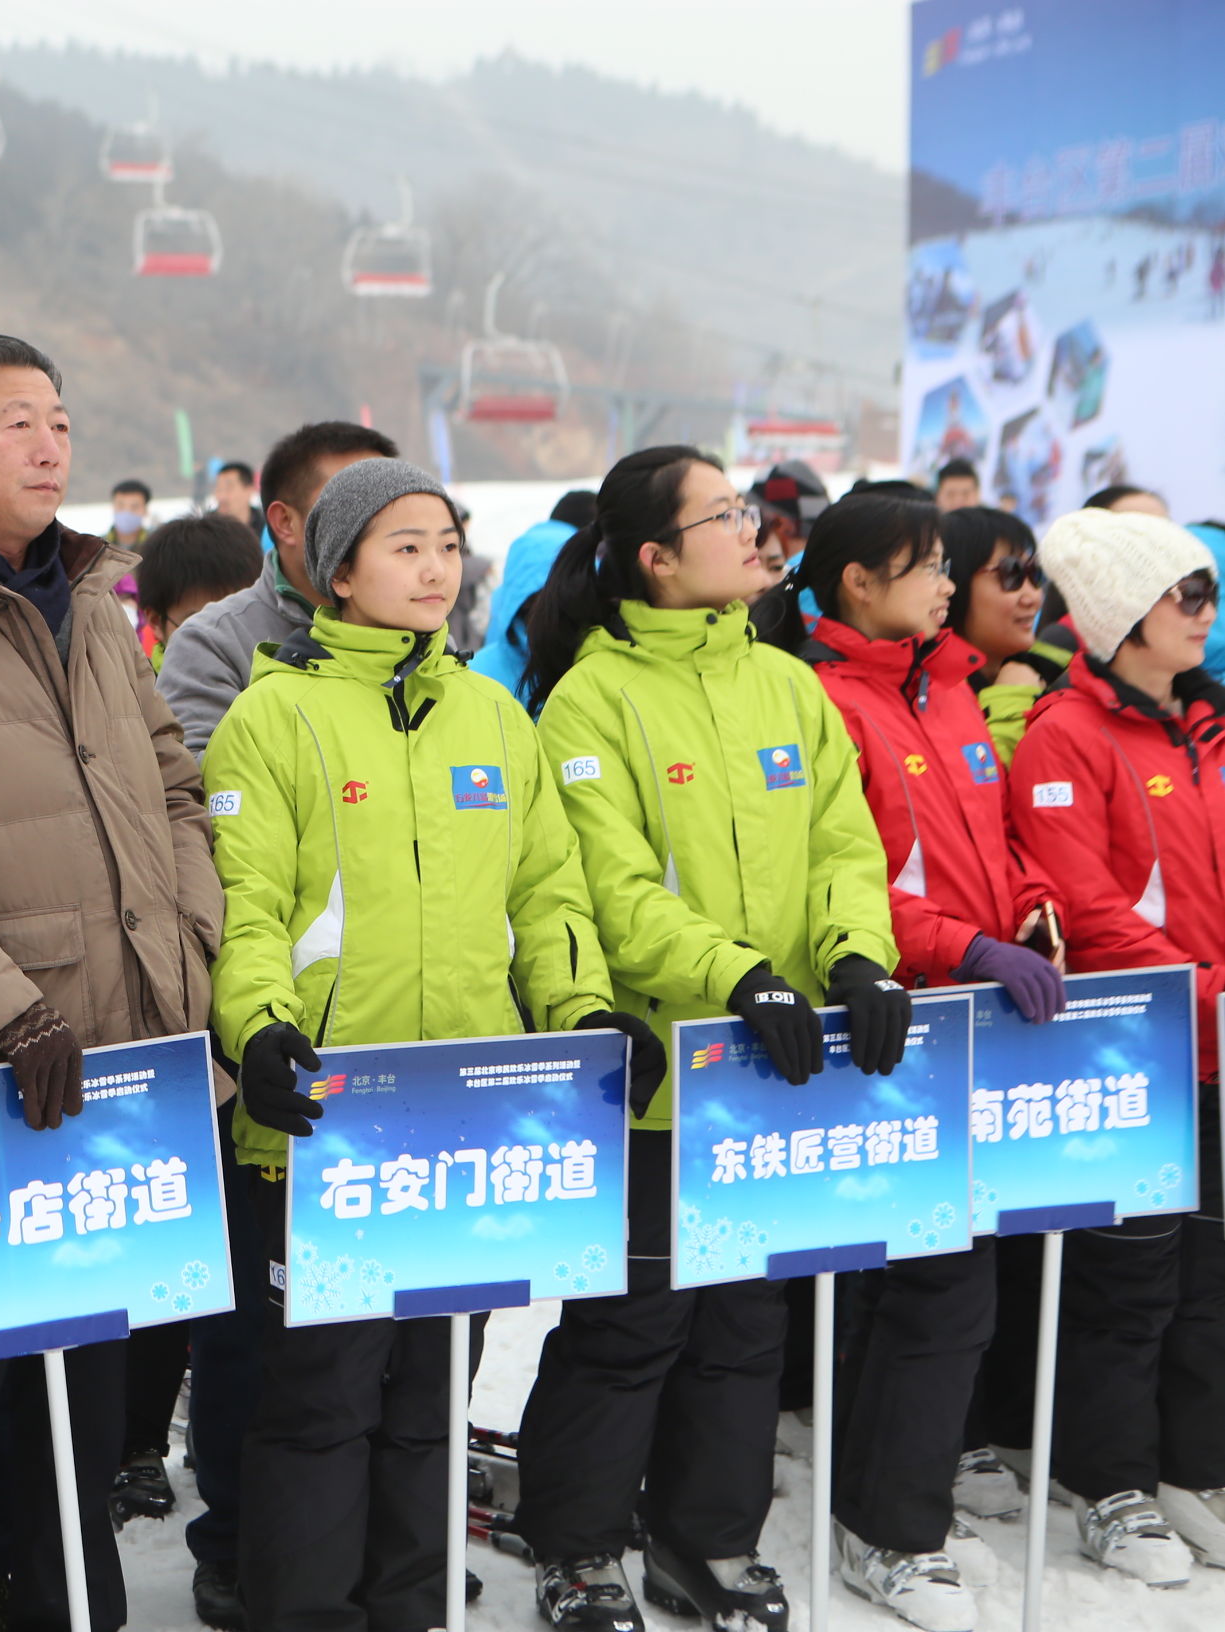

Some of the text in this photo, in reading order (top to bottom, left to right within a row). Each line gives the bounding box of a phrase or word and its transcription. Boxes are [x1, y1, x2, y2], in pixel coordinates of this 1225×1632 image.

[564, 760, 596, 779] 165
[1038, 786, 1069, 803] 155
[972, 1072, 1151, 1143] 南苑街道
[319, 1139, 598, 1220] 右安门街道
[711, 1115, 939, 1184] 东铁匠营街道
